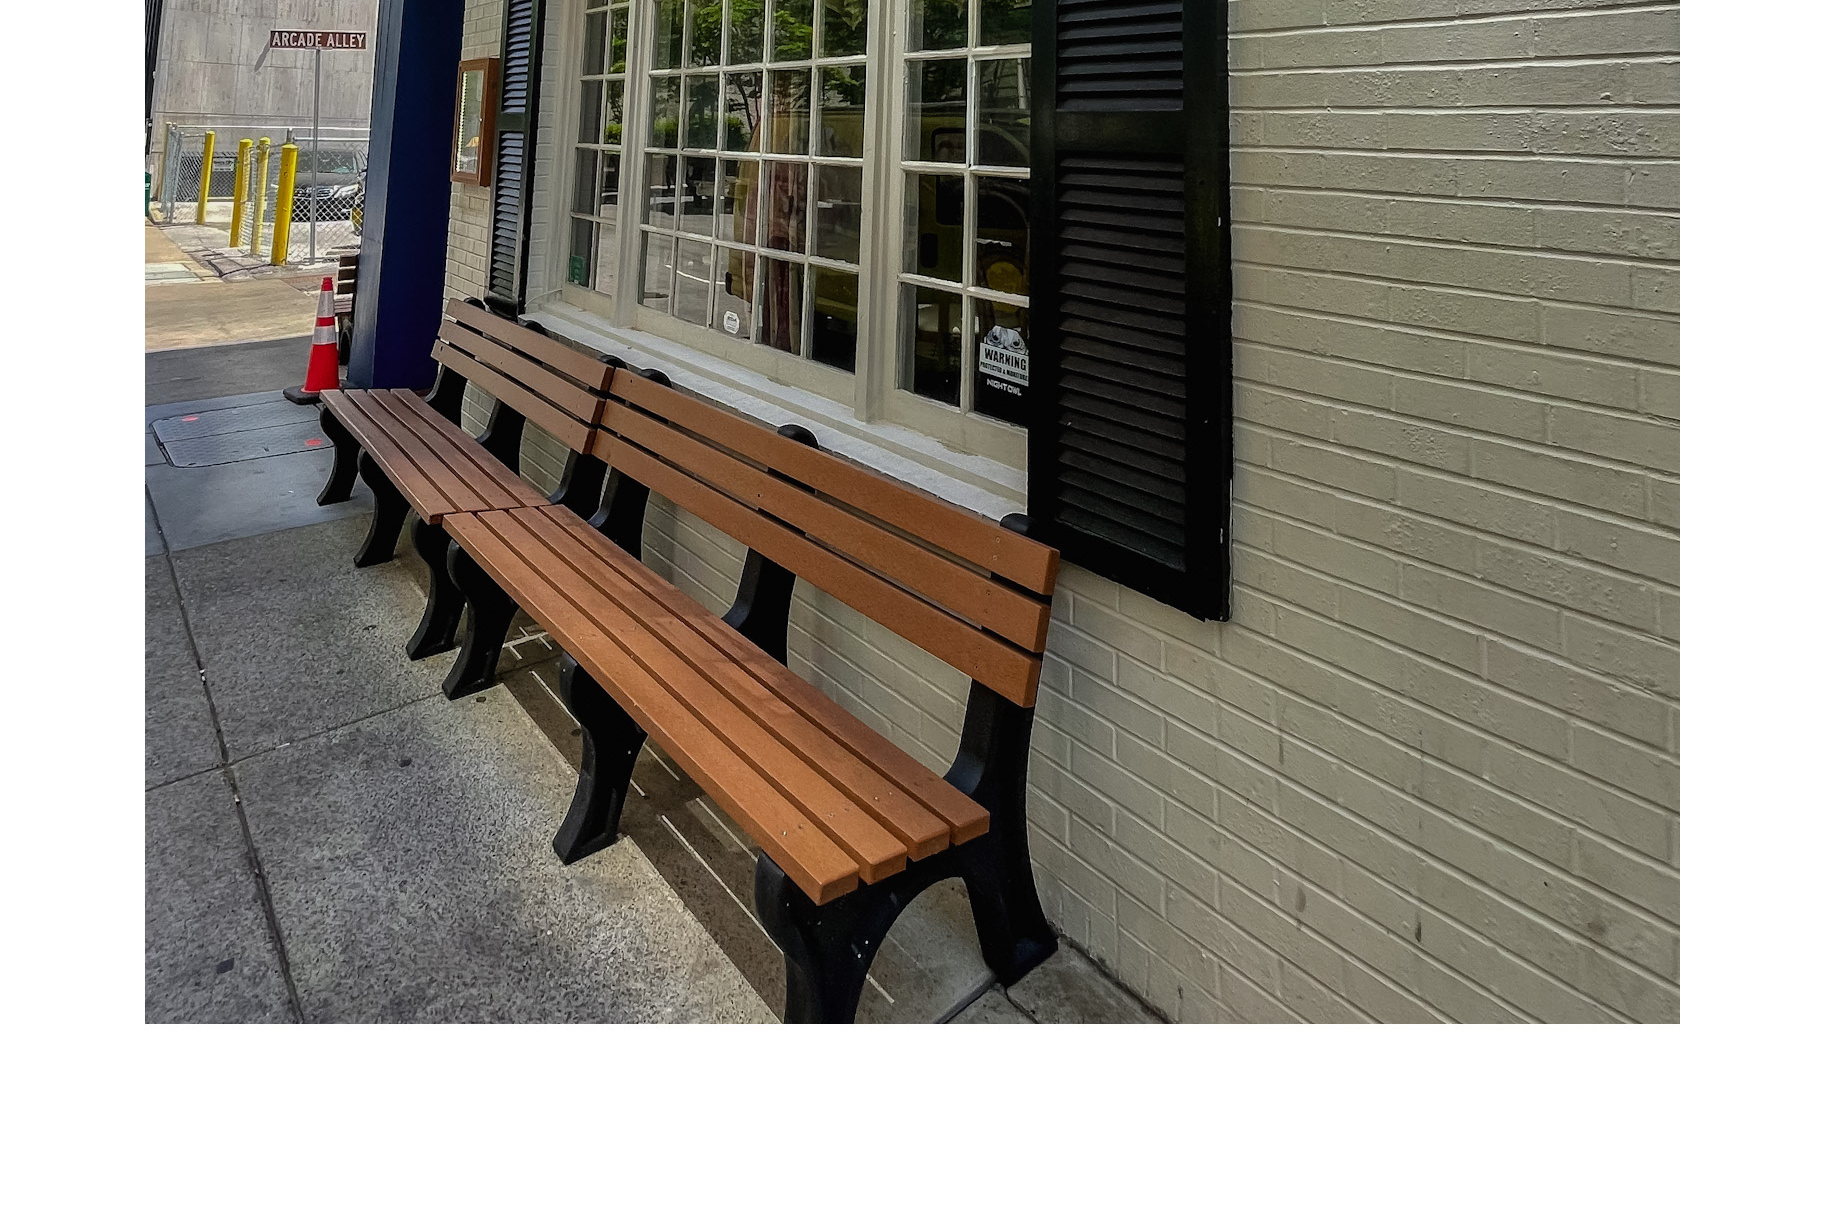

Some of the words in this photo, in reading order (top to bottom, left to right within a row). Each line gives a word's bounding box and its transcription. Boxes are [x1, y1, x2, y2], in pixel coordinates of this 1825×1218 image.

[272, 31, 323, 47] ARCADE
[326, 33, 365, 48] ALLEY
[984, 348, 1027, 371] WARNING
